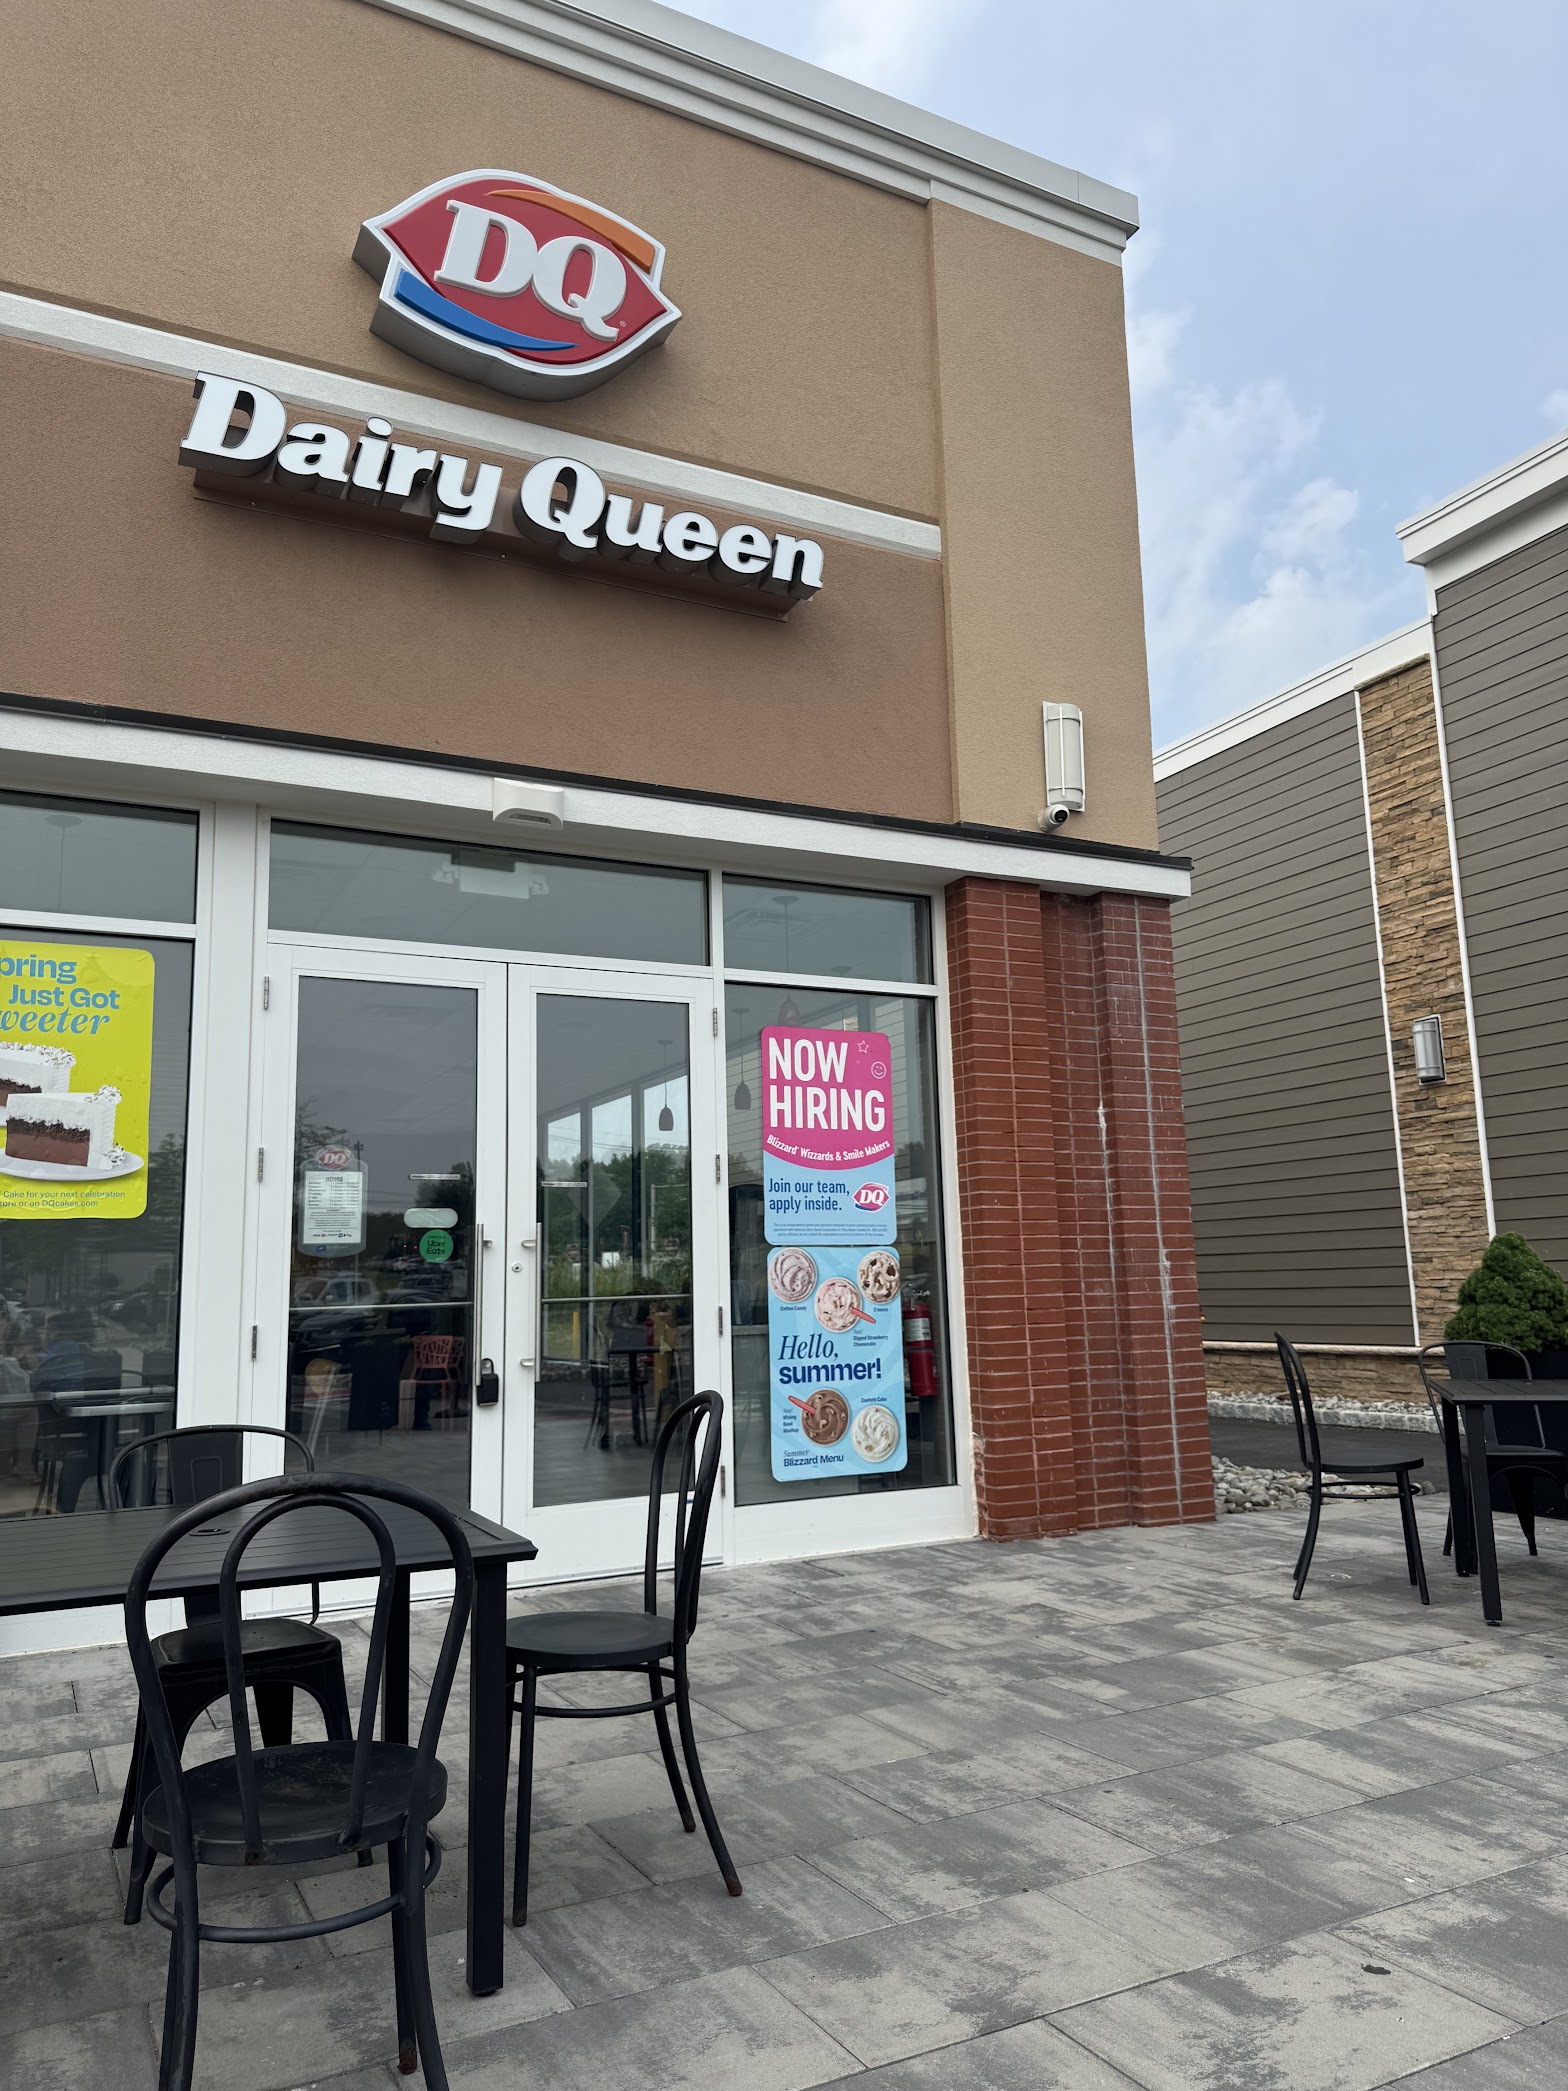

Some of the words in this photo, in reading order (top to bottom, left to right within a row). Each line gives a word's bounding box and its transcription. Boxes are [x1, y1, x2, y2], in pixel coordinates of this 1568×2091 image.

[433, 199, 628, 342] DQ
[179, 370, 503, 533] Dairy
[514, 455, 824, 596] Queen
[8, 984, 65, 1007] Just
[69, 987, 121, 1010] Got
[768, 1037, 849, 1083] NOW
[769, 1084, 886, 1132] HIRING
[323, 1152, 347, 1166] DQ
[800, 1147, 834, 1162] Wizzards
[835, 1151, 842, 1161] &
[843, 1149, 865, 1161] Smile
[864, 1140, 891, 1156] Makers
[3, 1190, 25, 1198] Cake
[26, 1190, 39, 1198] for
[40, 1191, 58, 1199] your
[80, 1190, 126, 1198] celebration
[768, 1178, 791, 1193] Join
[794, 1182, 814, 1194] our
[817, 1180, 850, 1196] team,
[41, 1199, 99, 1208] DQcakes.com
[769, 1196, 801, 1214] apply
[804, 1196, 842, 1211] inside.
[859, 1189, 885, 1206] DQ
[426, 1247, 446, 1255] Eats
[427, 1239, 446, 1247] Uber
[778, 1333, 838, 1360] Hello,
[779, 1358, 882, 1384] summer!
[783, 1449, 810, 1457] Summer
[783, 1455, 818, 1467] Blizzard
[820, 1454, 844, 1464] Menu
